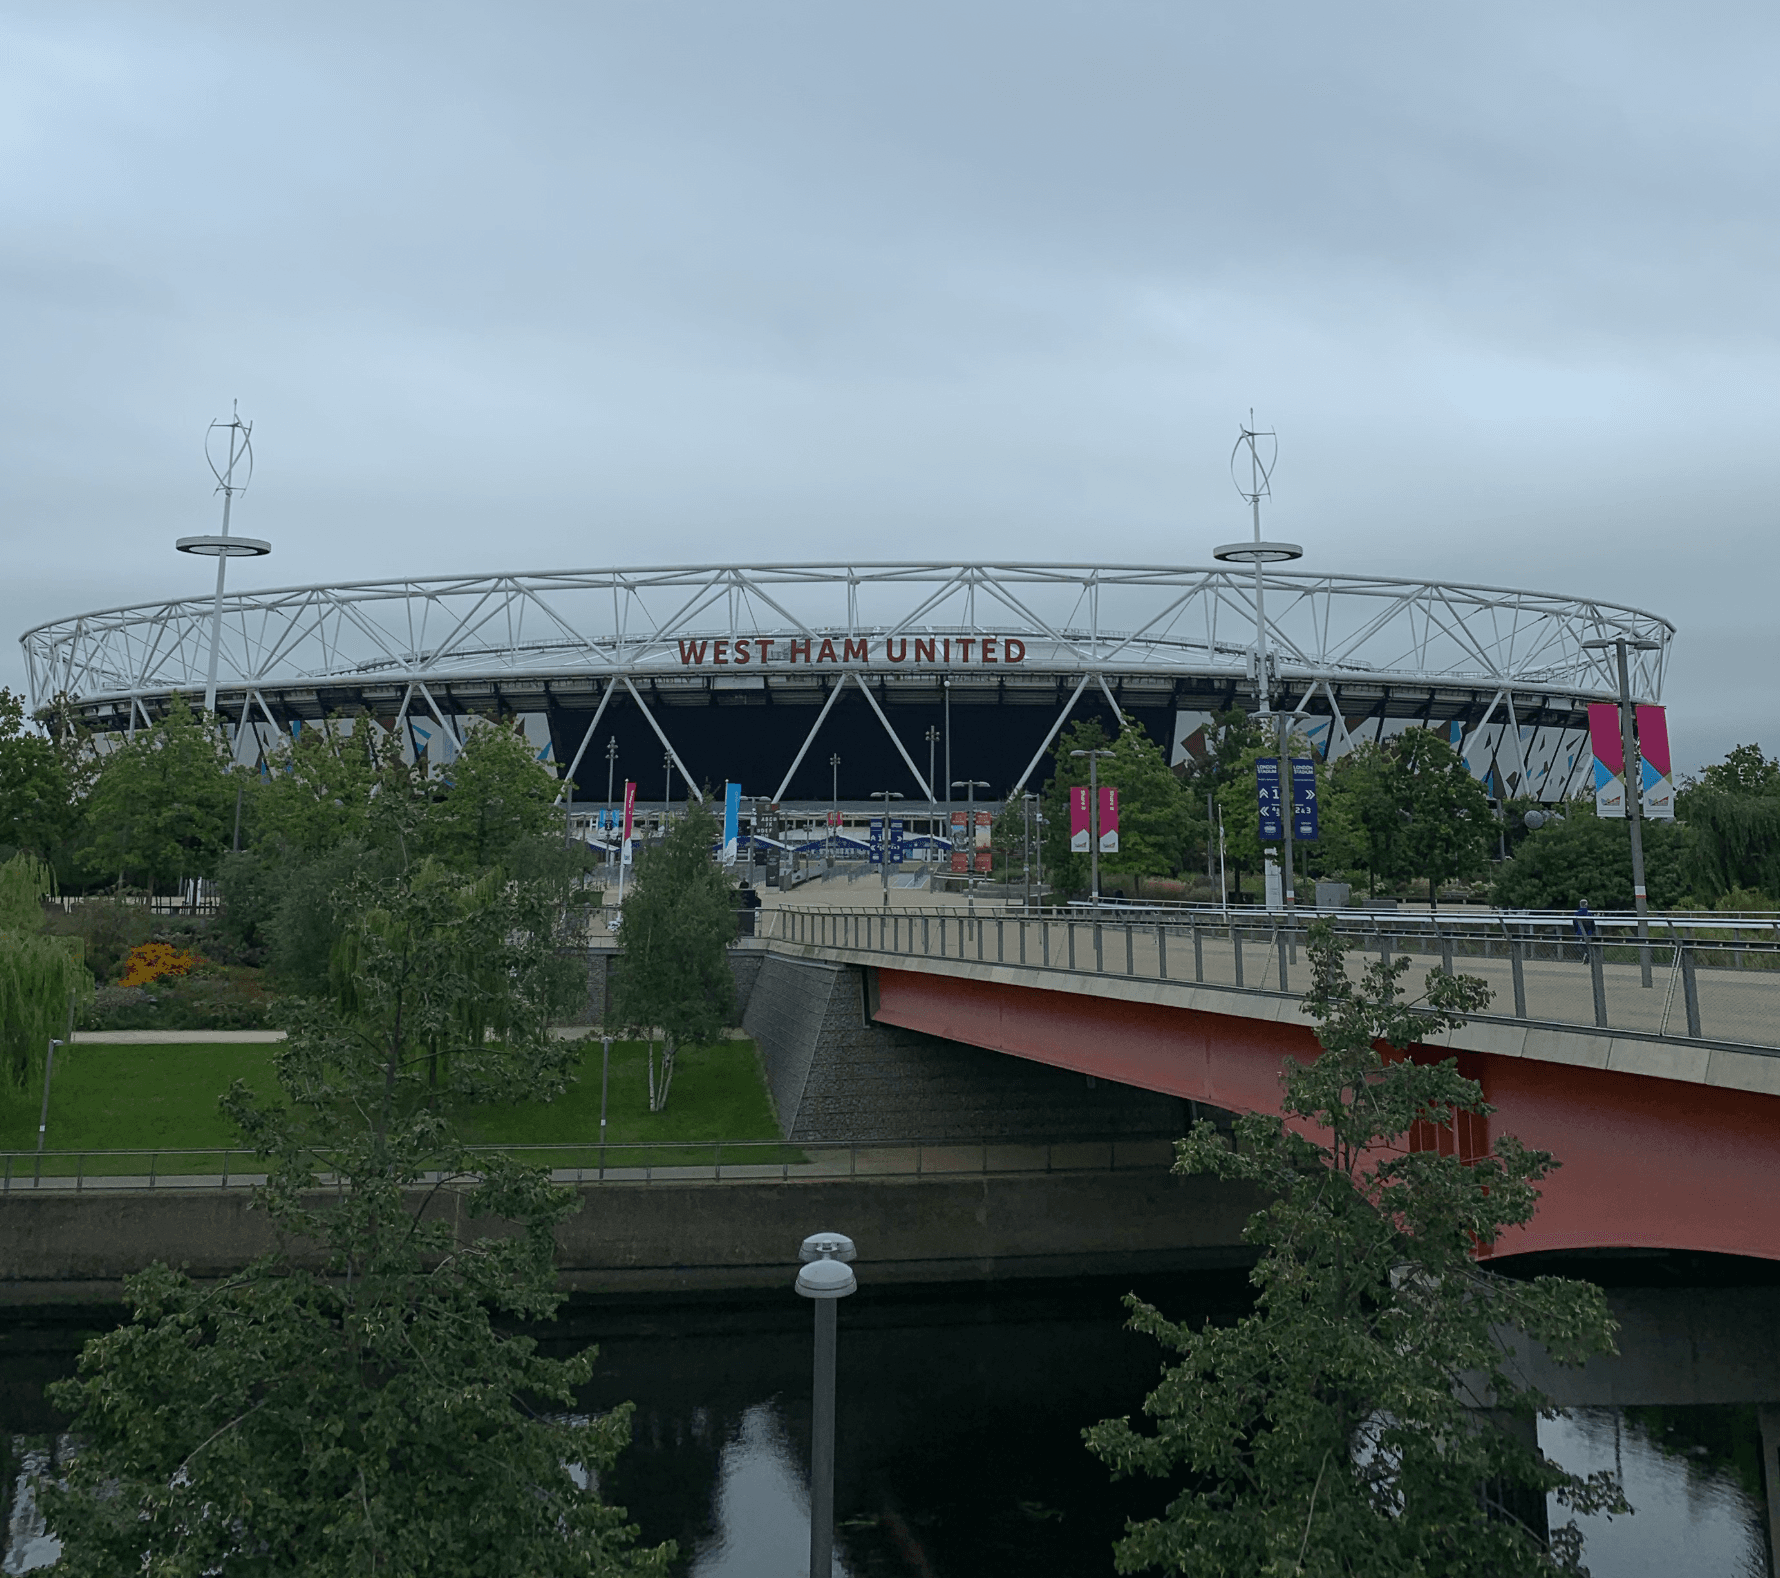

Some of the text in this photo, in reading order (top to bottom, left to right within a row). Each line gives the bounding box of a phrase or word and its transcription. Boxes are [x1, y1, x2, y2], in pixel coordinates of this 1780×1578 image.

[678, 638, 1026, 664] WEST HAM UNITED
[1272, 789, 1279, 799] 1
